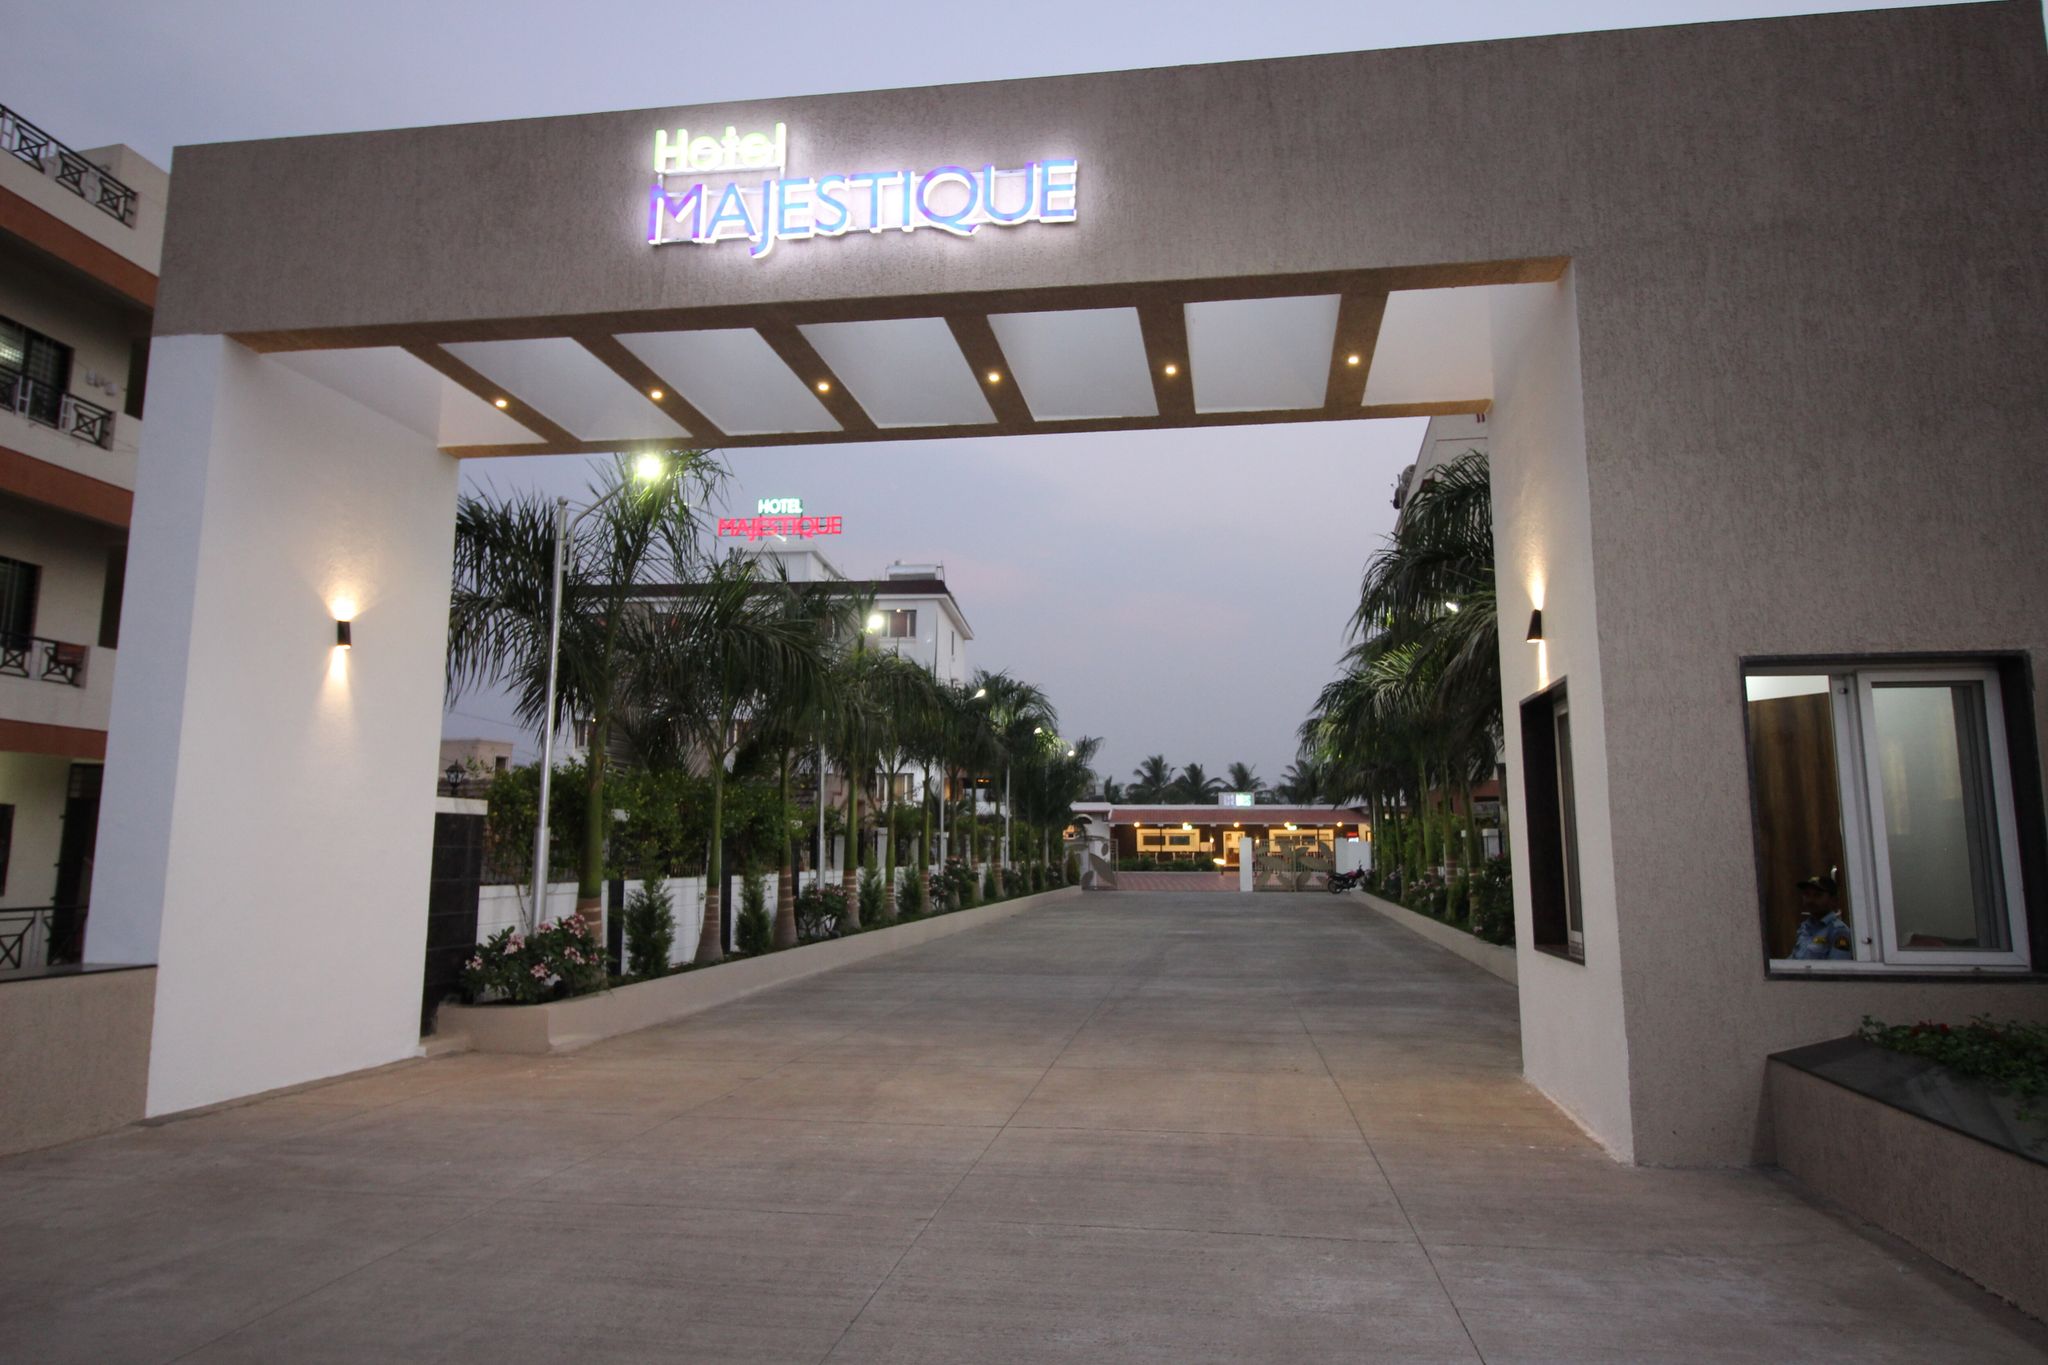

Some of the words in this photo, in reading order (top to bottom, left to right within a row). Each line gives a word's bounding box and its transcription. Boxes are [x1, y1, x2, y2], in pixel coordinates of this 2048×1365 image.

[655, 122, 787, 172] Hotel
[648, 159, 1078, 260] MAJESTIQUE
[758, 498, 803, 514] HOTEL
[718, 515, 842, 541] MAJESTIQUE
